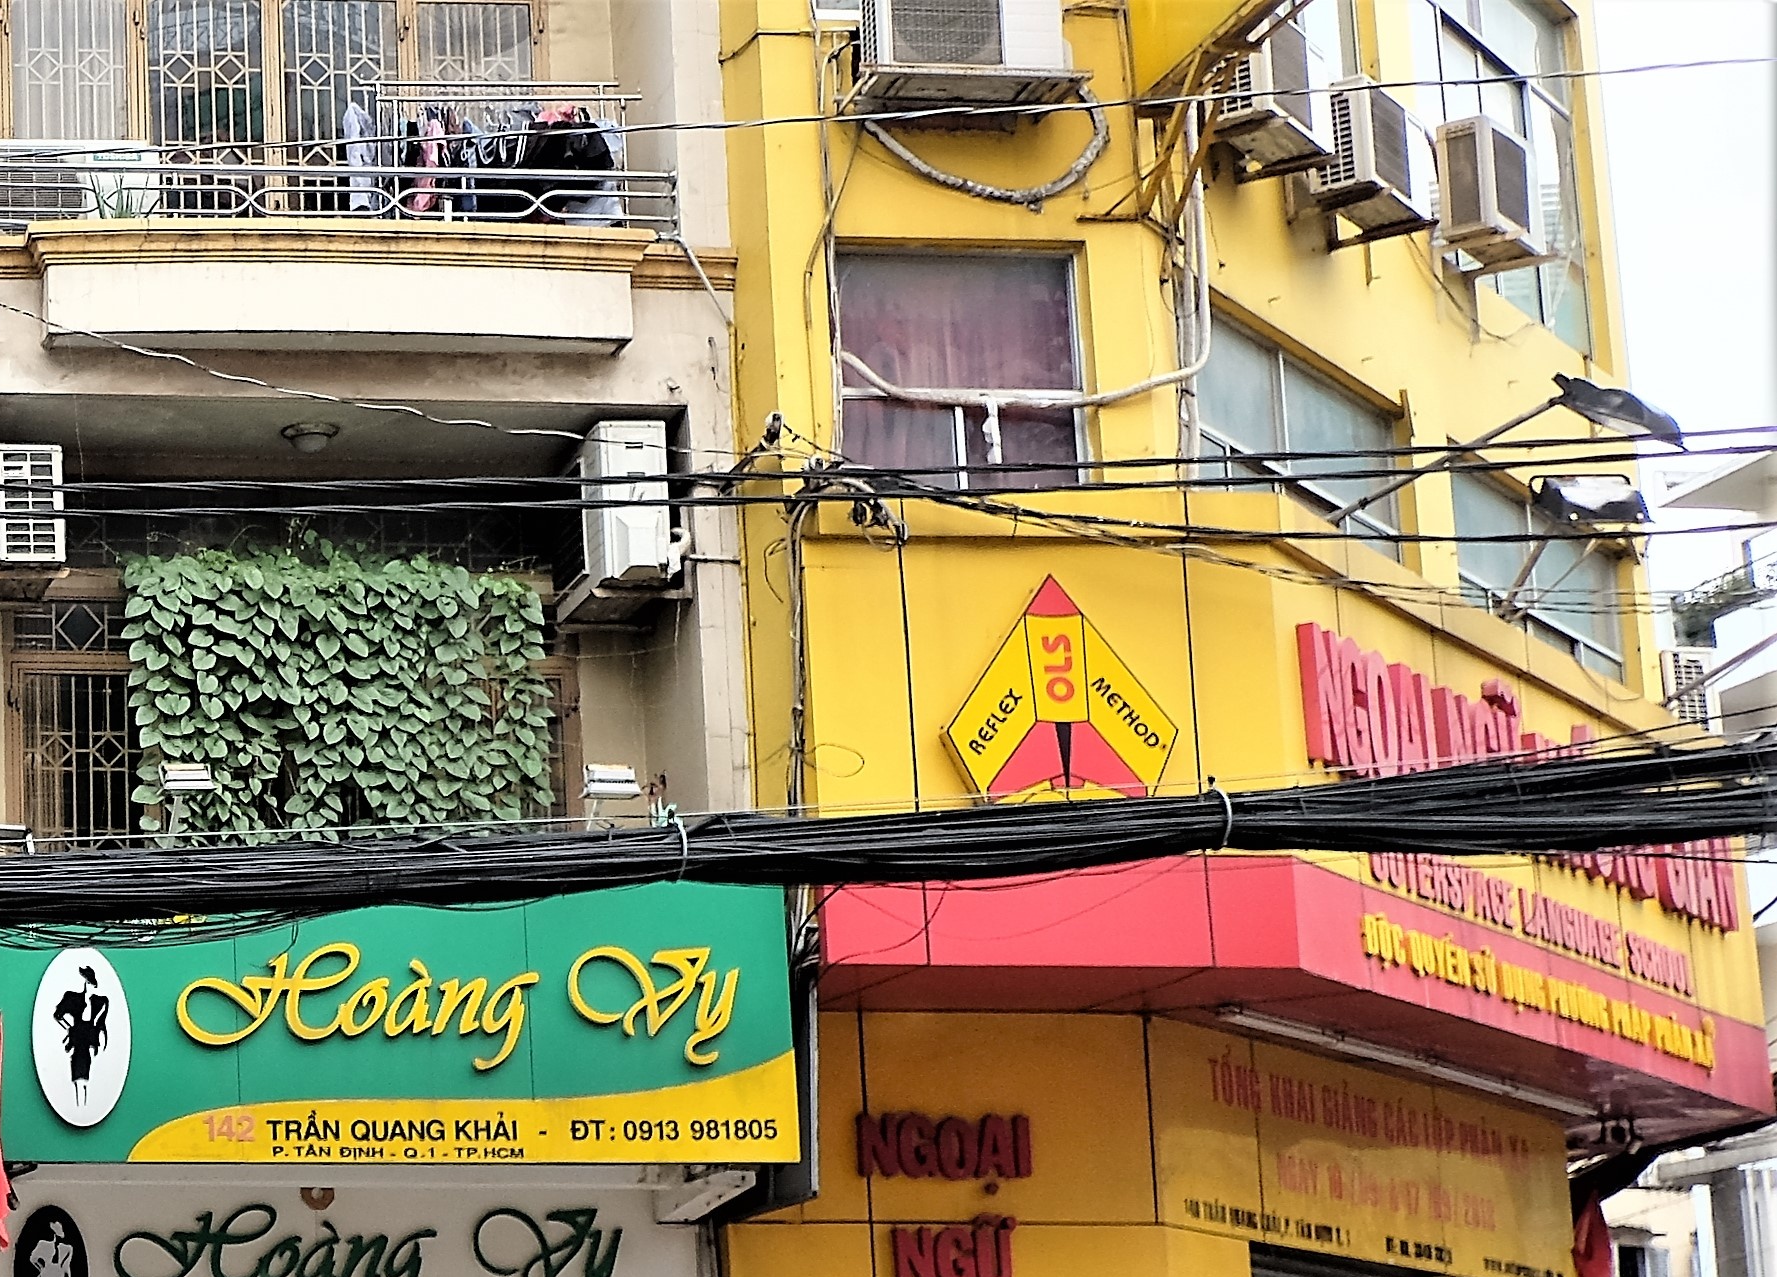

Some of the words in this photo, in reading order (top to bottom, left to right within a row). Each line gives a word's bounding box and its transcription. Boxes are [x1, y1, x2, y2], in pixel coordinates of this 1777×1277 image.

[1042, 634, 1075, 704] OLS
[969, 688, 1023, 755] REFLEX
[1090, 677, 1160, 749] METHOD
[1519, 888, 1621, 968] LANGUAGE
[1627, 931, 1692, 996] SCHOOL
[175, 942, 540, 1073] Hoàng
[568, 945, 742, 1067] Vy
[202, 1115, 256, 1142] 142
[267, 1110, 341, 1141] TRẦN
[351, 1119, 446, 1142] QUANG
[454, 1112, 519, 1141] KHẢI
[623, 1119, 680, 1142] 0913
[691, 1118, 778, 1142] 981805
[272, 1146, 288, 1158] P.
[295, 1143, 333, 1158] TÂN
[339, 1146, 385, 1160] ĐỊNH
[453, 1146, 525, 1159] TP.HCM
[854, 1112, 1033, 1196] NGOẠI
